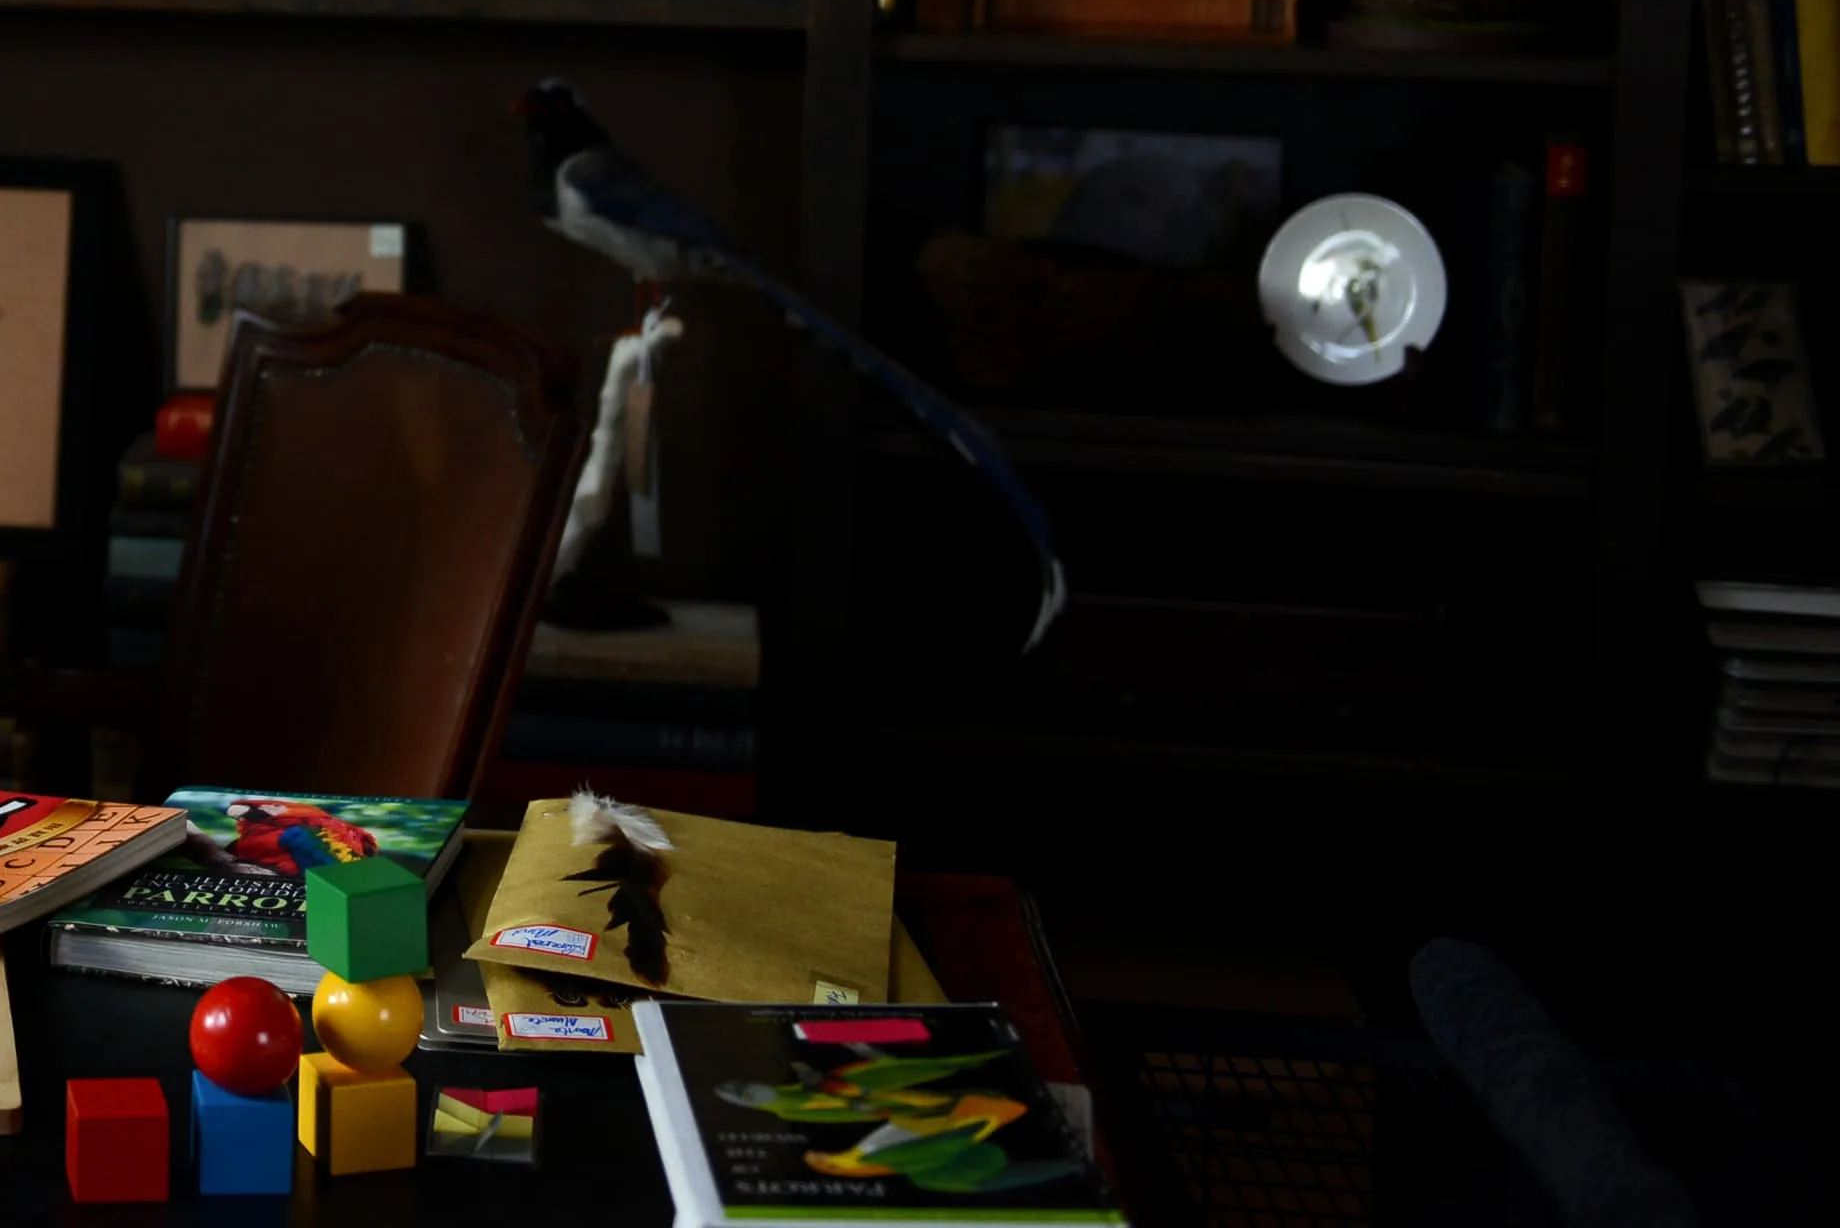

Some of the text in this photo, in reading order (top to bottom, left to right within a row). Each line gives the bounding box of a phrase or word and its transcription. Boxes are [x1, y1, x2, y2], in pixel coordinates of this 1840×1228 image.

[4, 858, 36, 869] C
[36, 836, 75, 849] D
[132, 878, 306, 898] ENCYCLOPEDI
